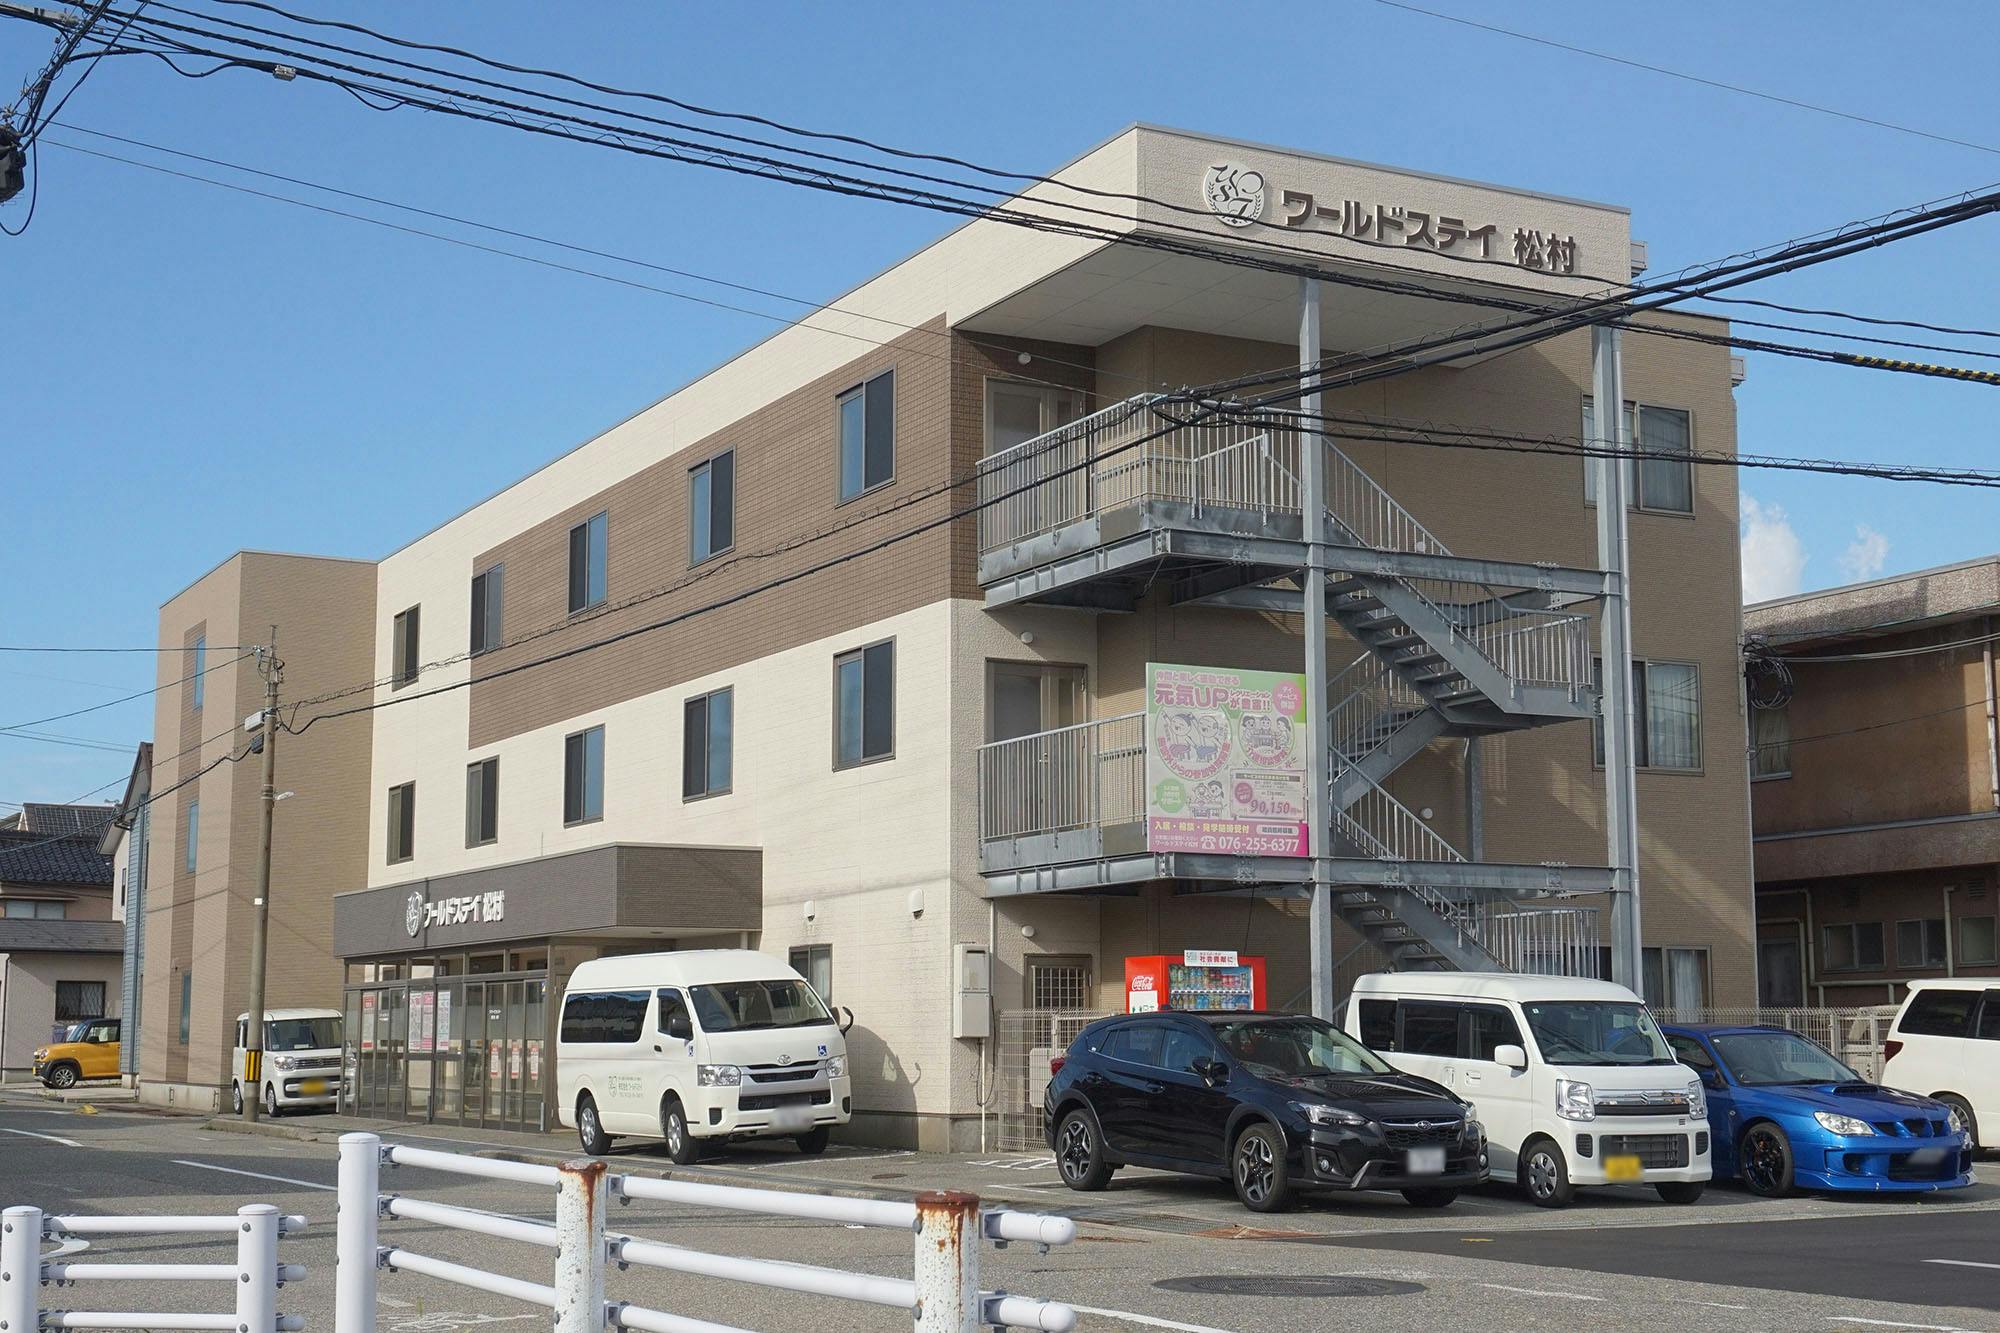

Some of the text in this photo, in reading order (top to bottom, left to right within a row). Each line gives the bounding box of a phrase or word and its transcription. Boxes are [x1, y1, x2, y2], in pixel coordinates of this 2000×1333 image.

[1281, 189, 1576, 273] ワールドステイ 松村
[1154, 682, 1229, 708] 元気UP
[1219, 836, 1300, 852] 076-255-6377
[423, 895, 482, 928] ワールドステイ
